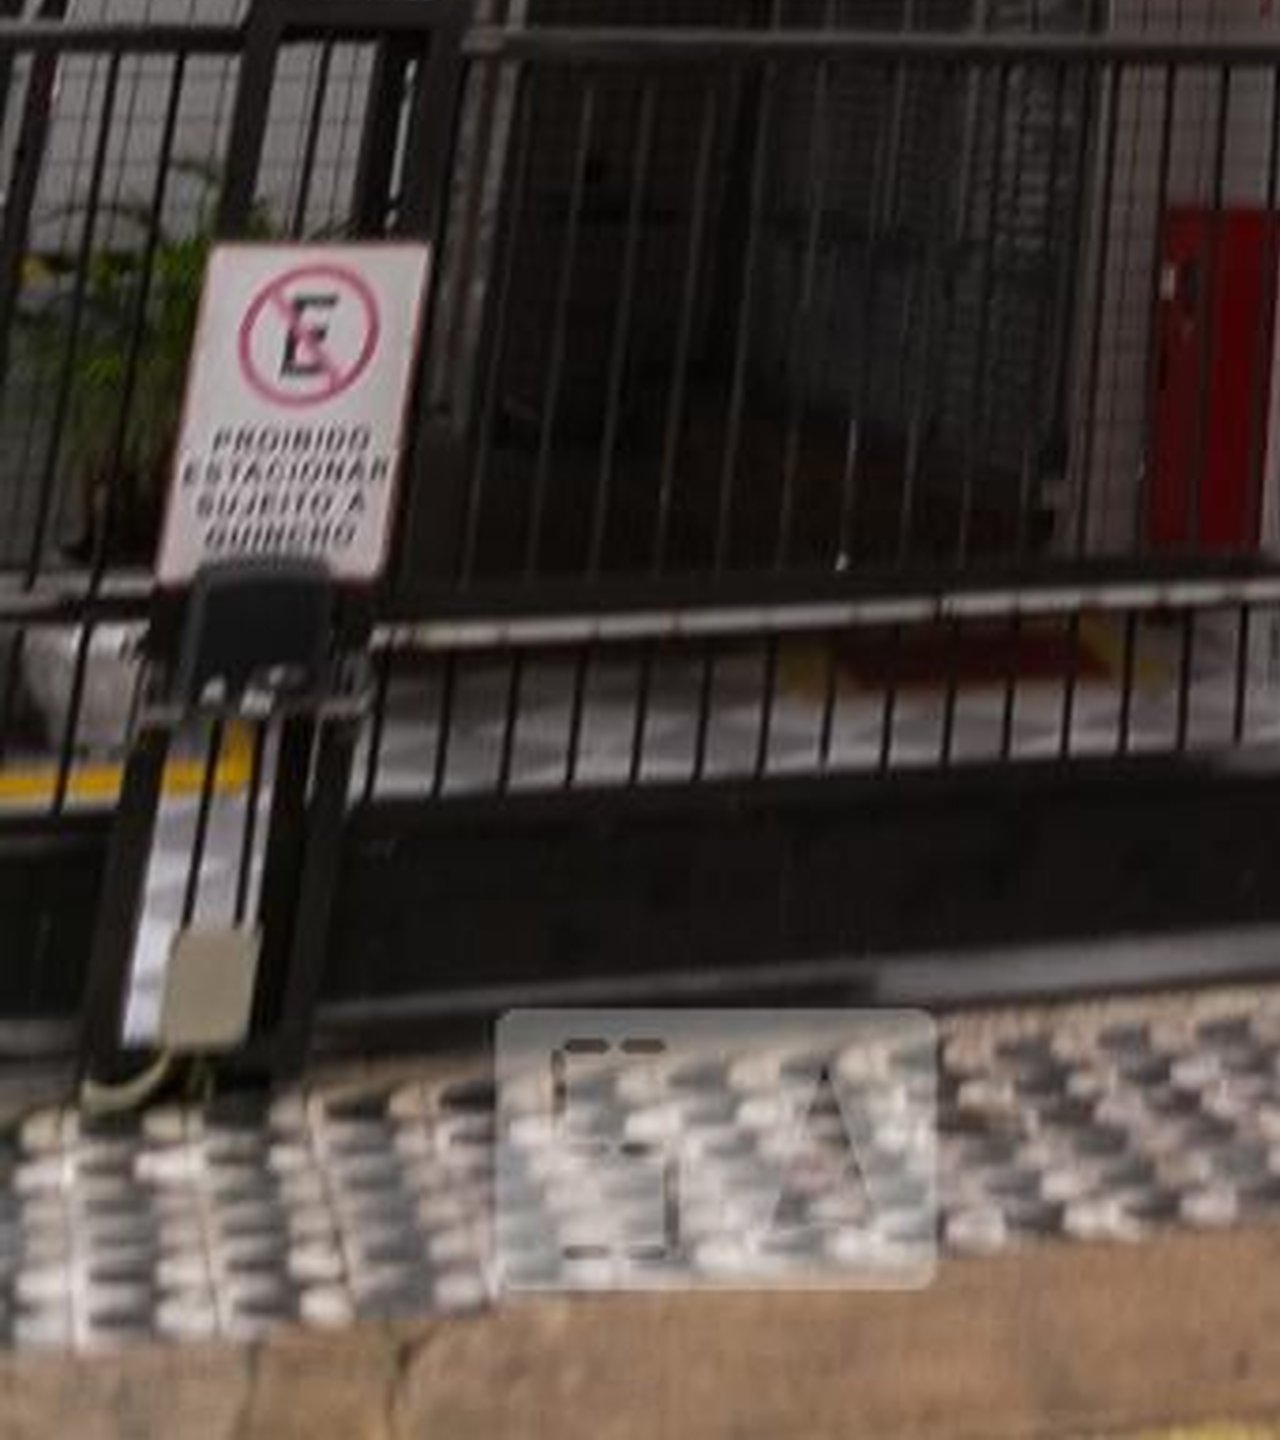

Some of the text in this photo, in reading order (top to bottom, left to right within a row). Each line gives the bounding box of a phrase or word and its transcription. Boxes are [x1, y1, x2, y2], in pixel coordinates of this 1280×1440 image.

[211, 424, 371, 453] PROIBIDO
[182, 454, 389, 485] ESTACIONAR
[196, 488, 334, 517] SUJEITO
